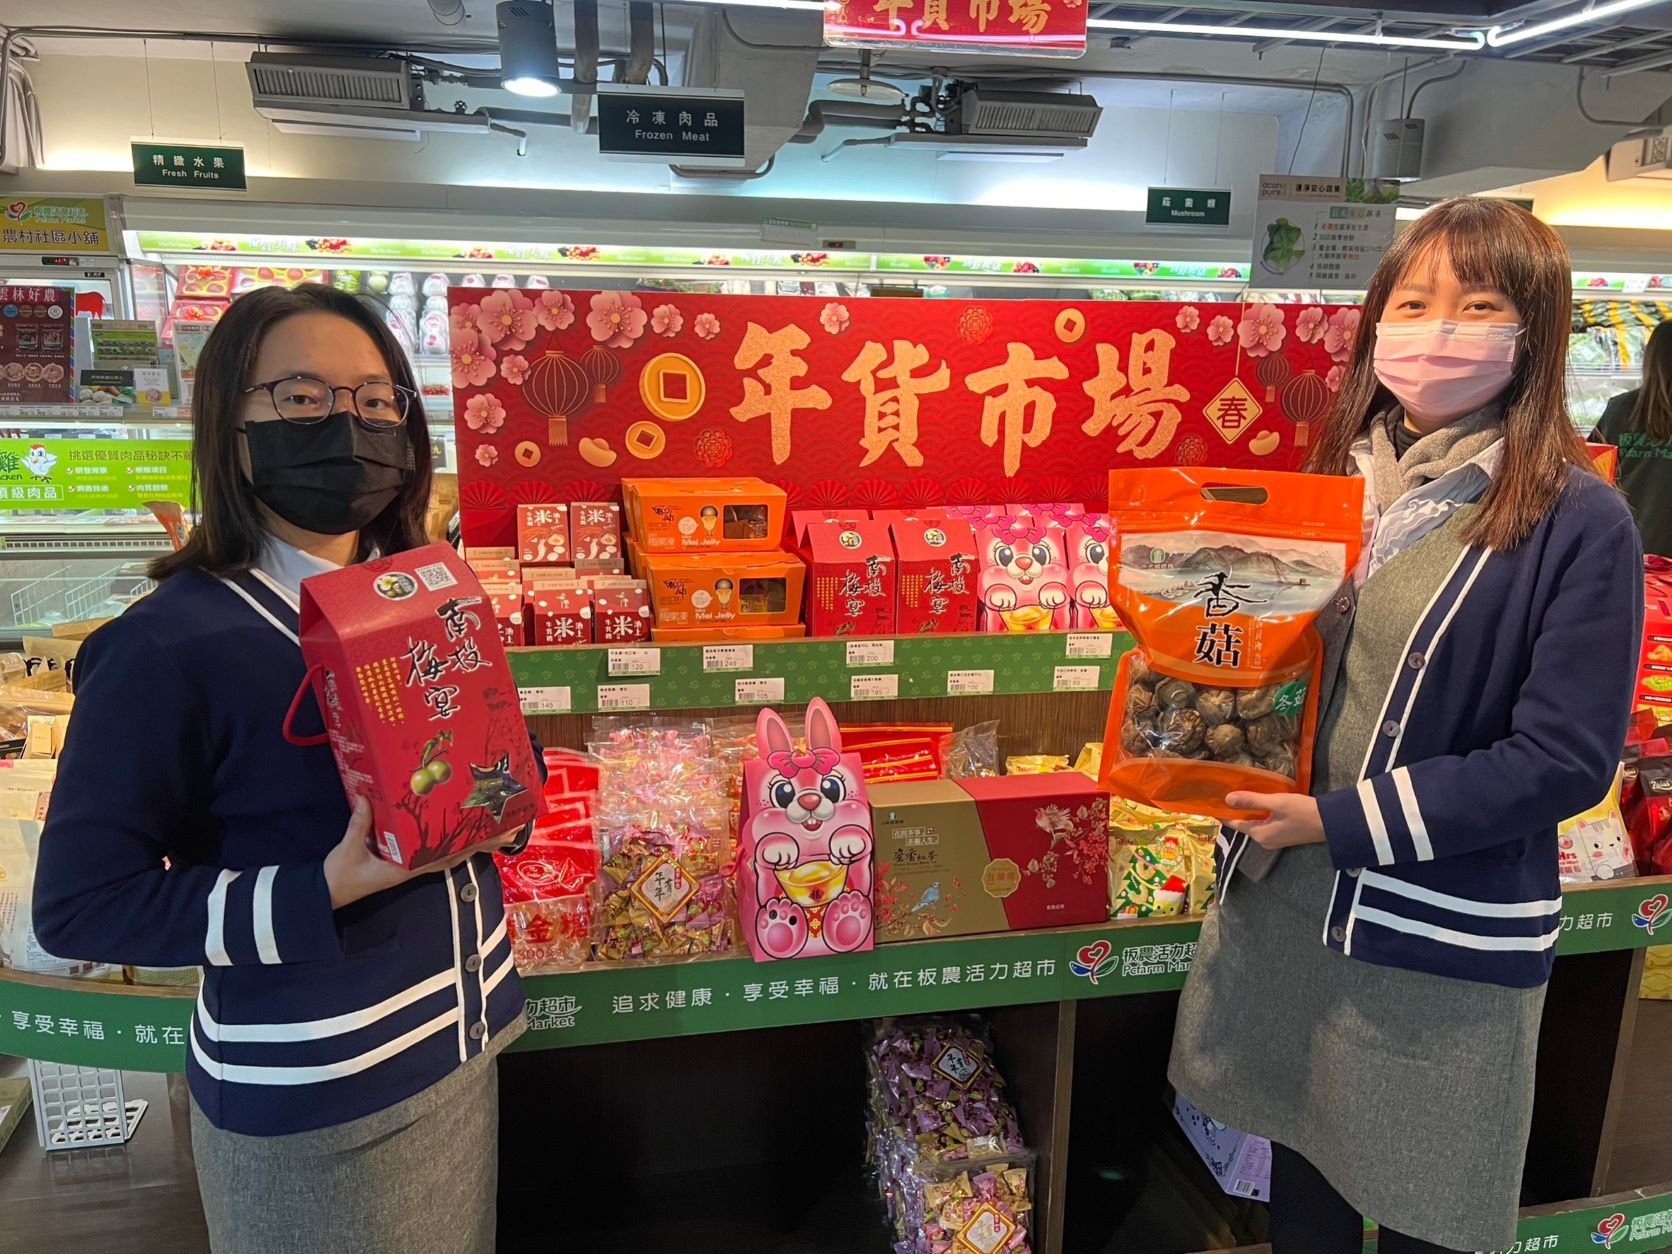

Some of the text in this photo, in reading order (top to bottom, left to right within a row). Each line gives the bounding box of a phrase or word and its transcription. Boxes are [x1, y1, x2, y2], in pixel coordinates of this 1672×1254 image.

[626, 109, 719, 127] 冷凍肉品
[635, 129, 710, 143] Frozen Meat
[162, 168, 219, 179] Fresh Fruits
[1171, 209, 1206, 218] Mushroom
[729, 321, 1191, 478] 年貨市場
[1216, 395, 1248, 430] 春
[695, 612, 713, 620] Mei
[714, 611, 736, 620] Jelly
[1193, 572, 1269, 668] 香菇
[612, 959, 1056, 1014] 追求健康 享受幸福 就在板農活力超市
[12, 1010, 186, 1045] 享受幸福 就在
